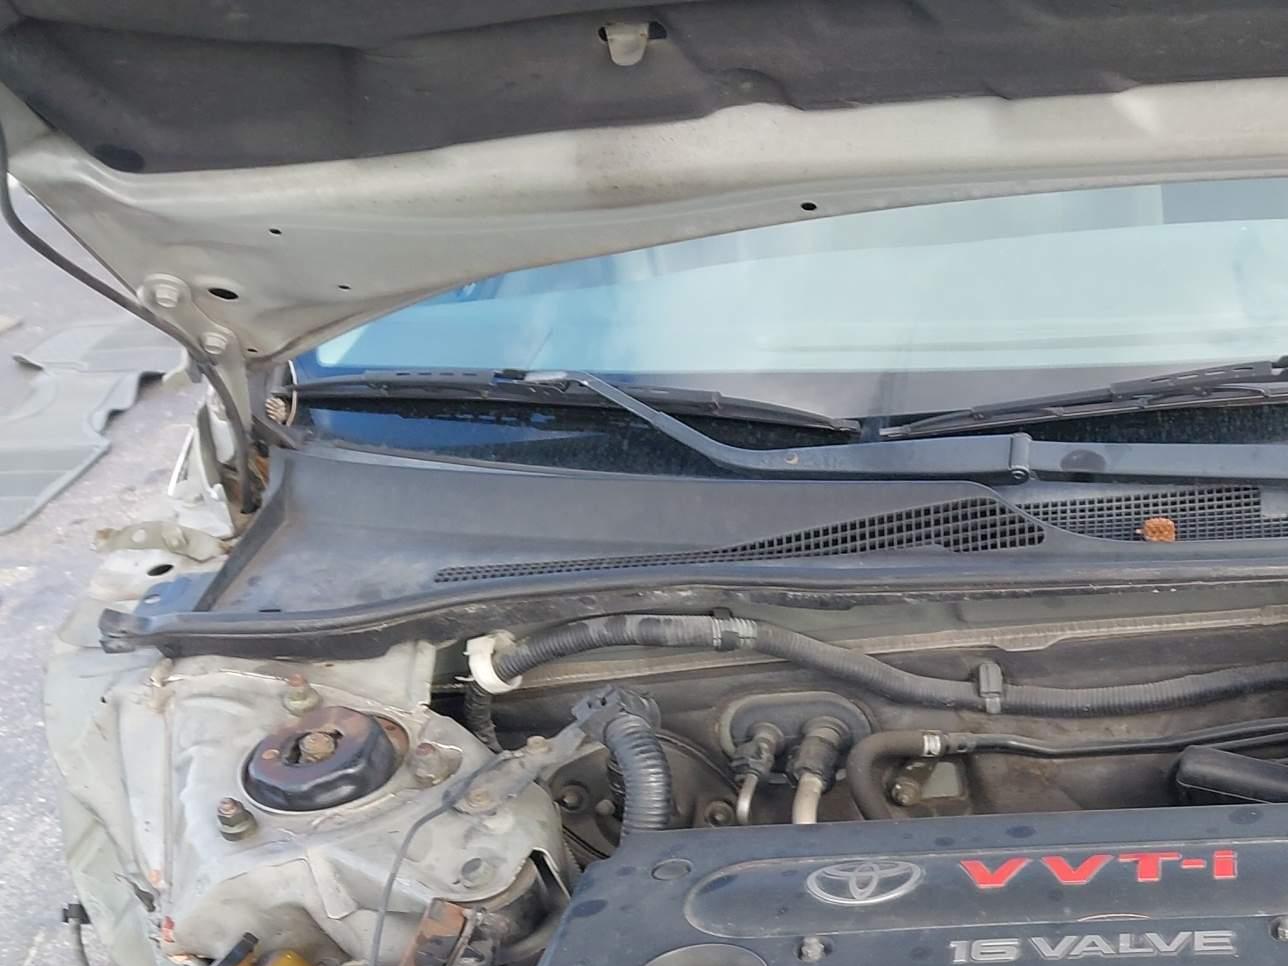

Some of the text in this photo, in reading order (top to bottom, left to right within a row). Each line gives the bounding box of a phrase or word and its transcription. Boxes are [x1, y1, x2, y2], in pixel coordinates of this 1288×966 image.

[959, 850, 1238, 888] VVT-i
[950, 930, 1239, 963] 16 VALVE
